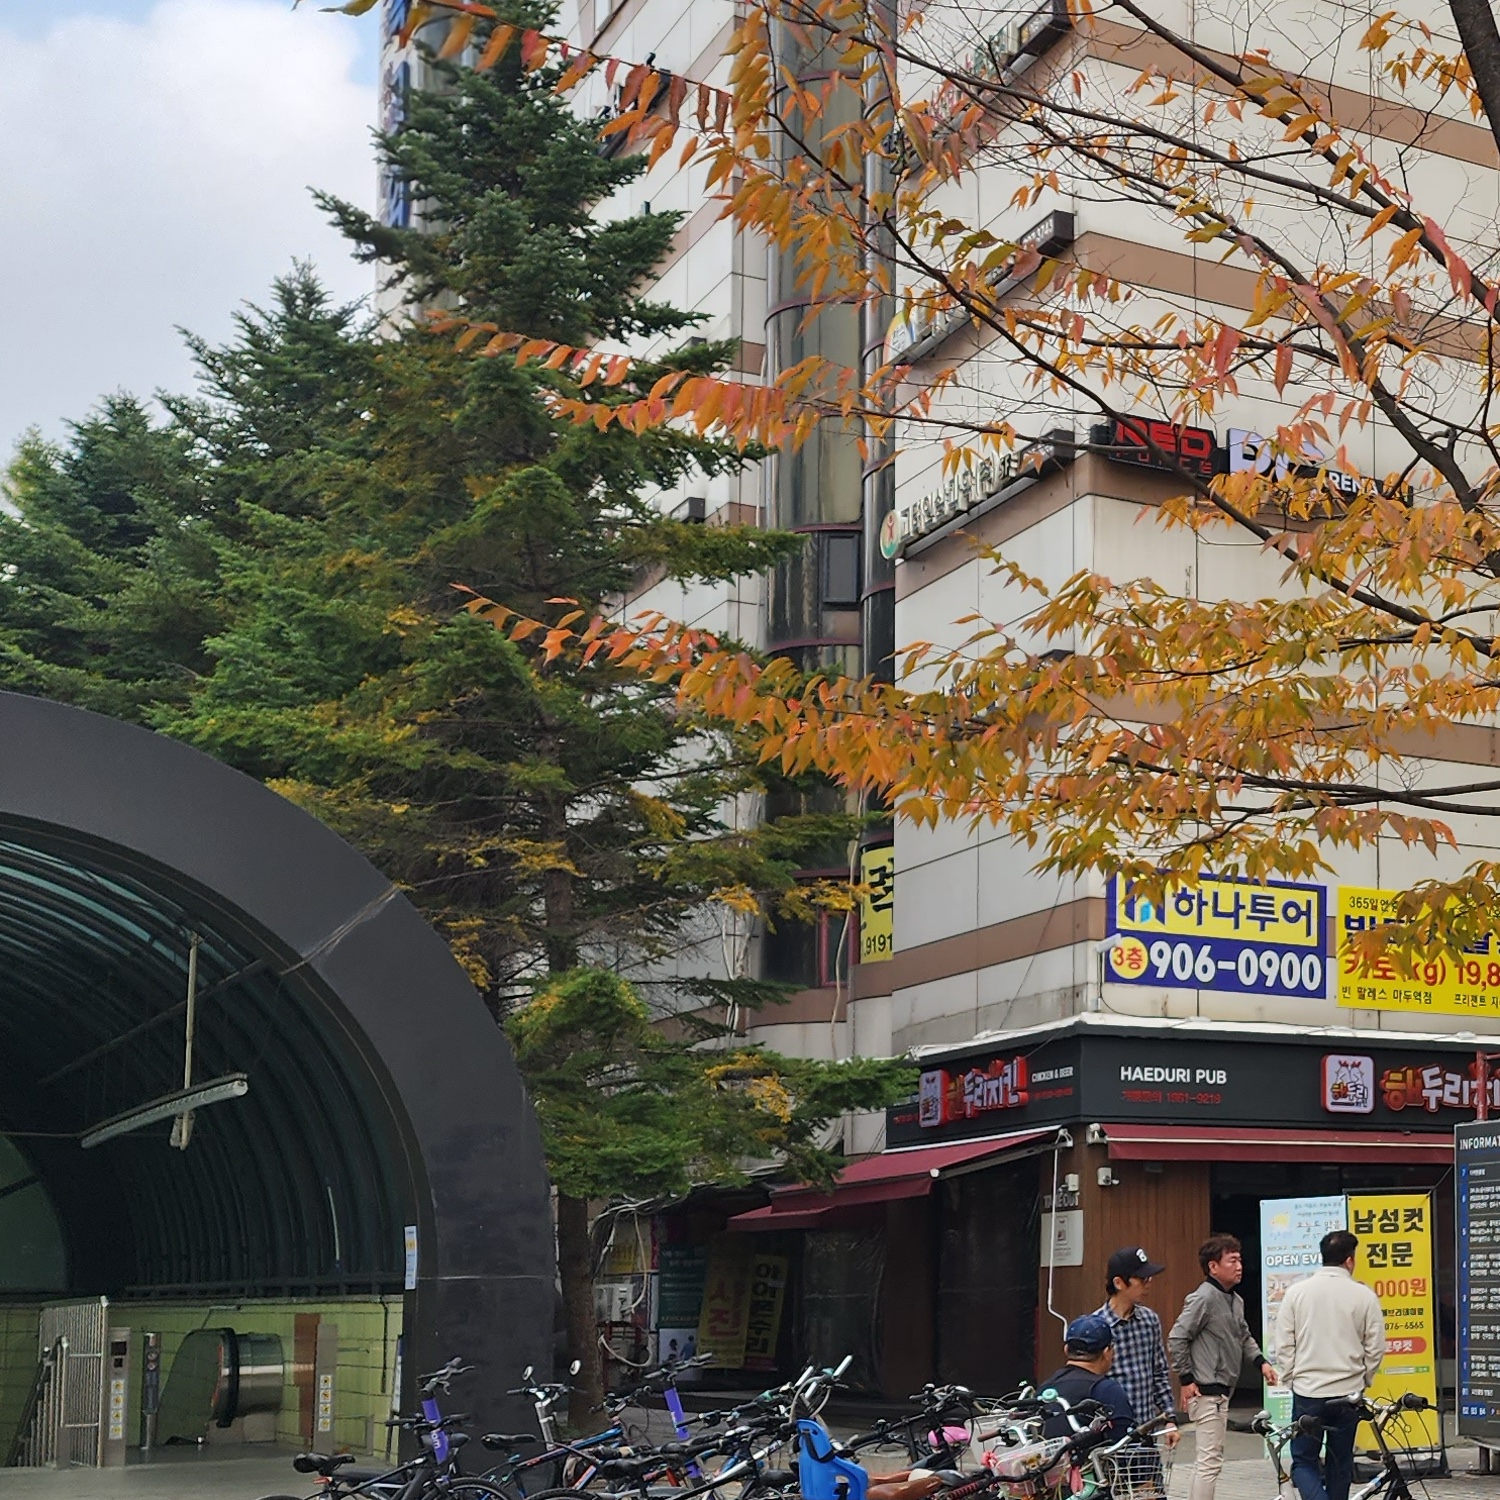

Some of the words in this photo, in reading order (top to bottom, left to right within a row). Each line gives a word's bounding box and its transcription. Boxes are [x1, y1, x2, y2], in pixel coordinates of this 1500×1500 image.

[1172, 887, 1312, 938] 하나투어
[1113, 946, 1143, 970] 3층
[1150, 940, 1323, 991] 906-0900
[1393, 989, 1432, 1005] 마두역점
[1120, 1066, 1190, 1083] HAEDURI
[1195, 1070, 1227, 1084] PUB
[1353, 1207, 1424, 1234] 남성컷
[1266, 1254, 1299, 1267] OPEN
[1366, 1241, 1414, 1268] 전문
